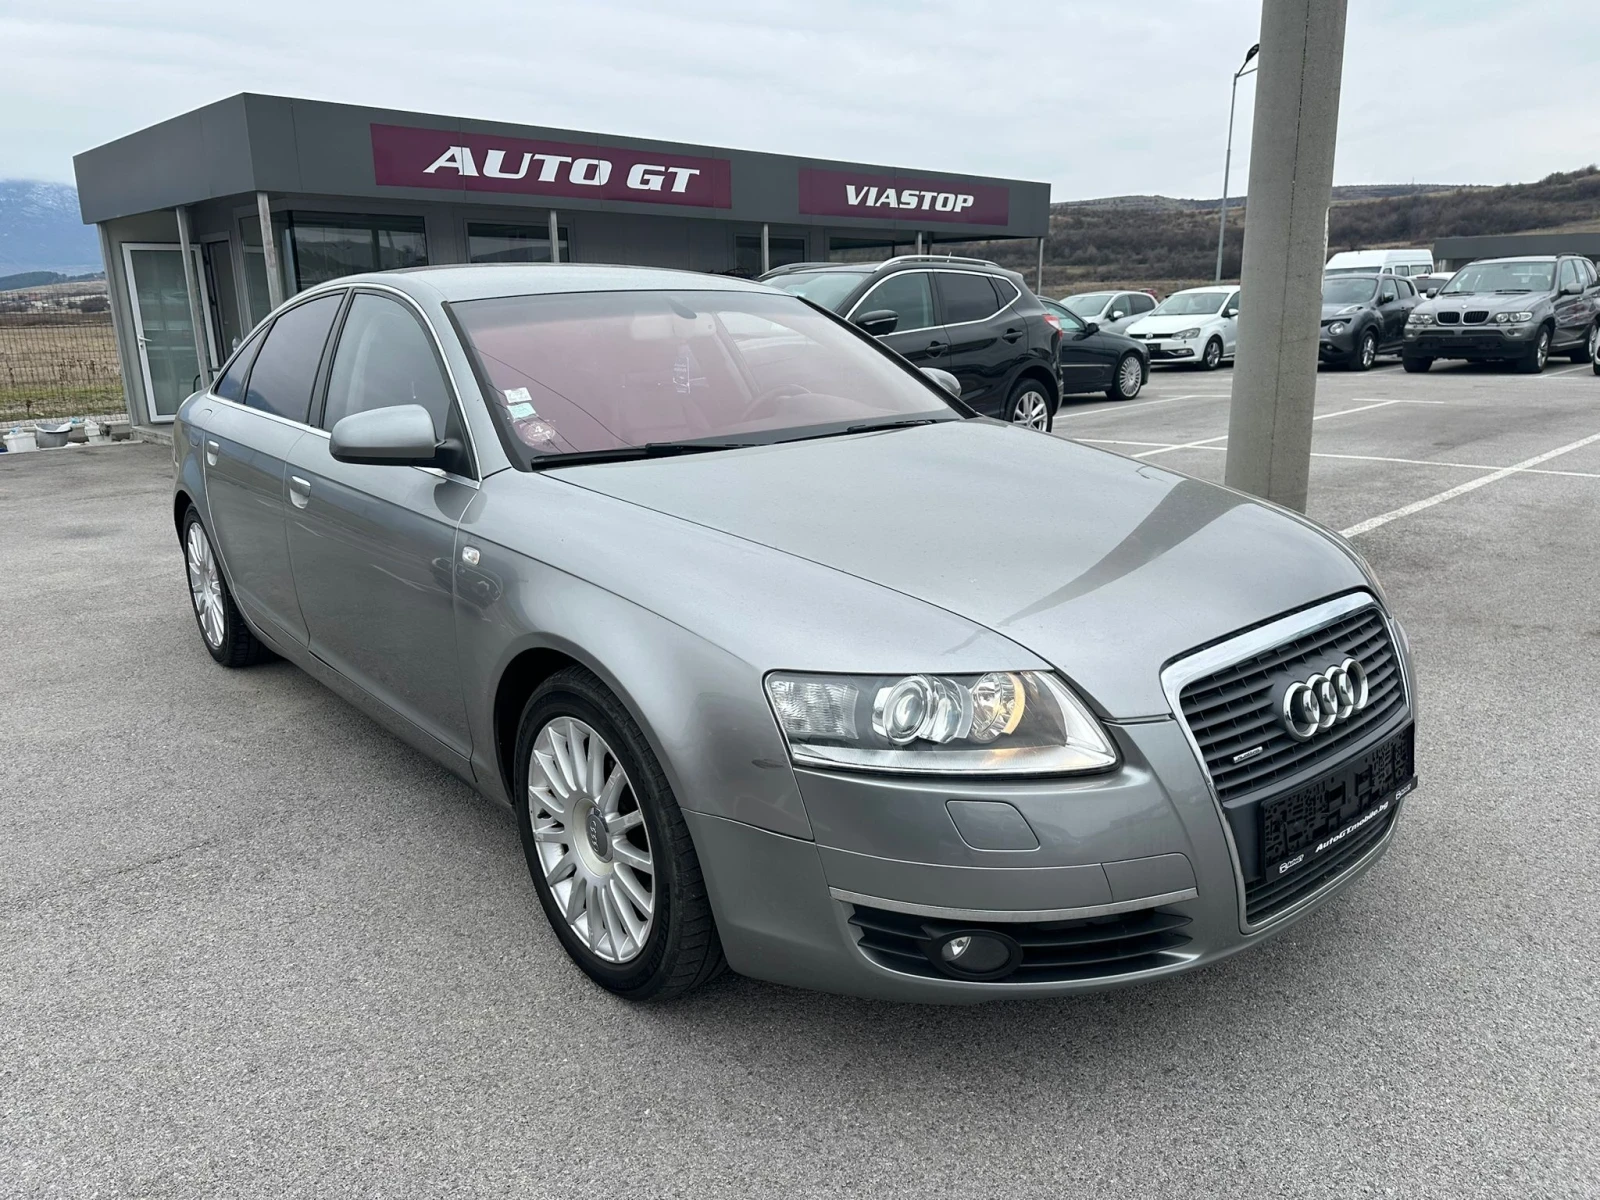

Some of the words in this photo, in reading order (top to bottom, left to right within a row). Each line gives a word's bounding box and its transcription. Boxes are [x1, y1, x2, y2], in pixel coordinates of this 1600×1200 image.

[422, 145, 613, 186] AUTO
[626, 163, 701, 193] GT
[845, 184, 975, 213] VIASTOP
